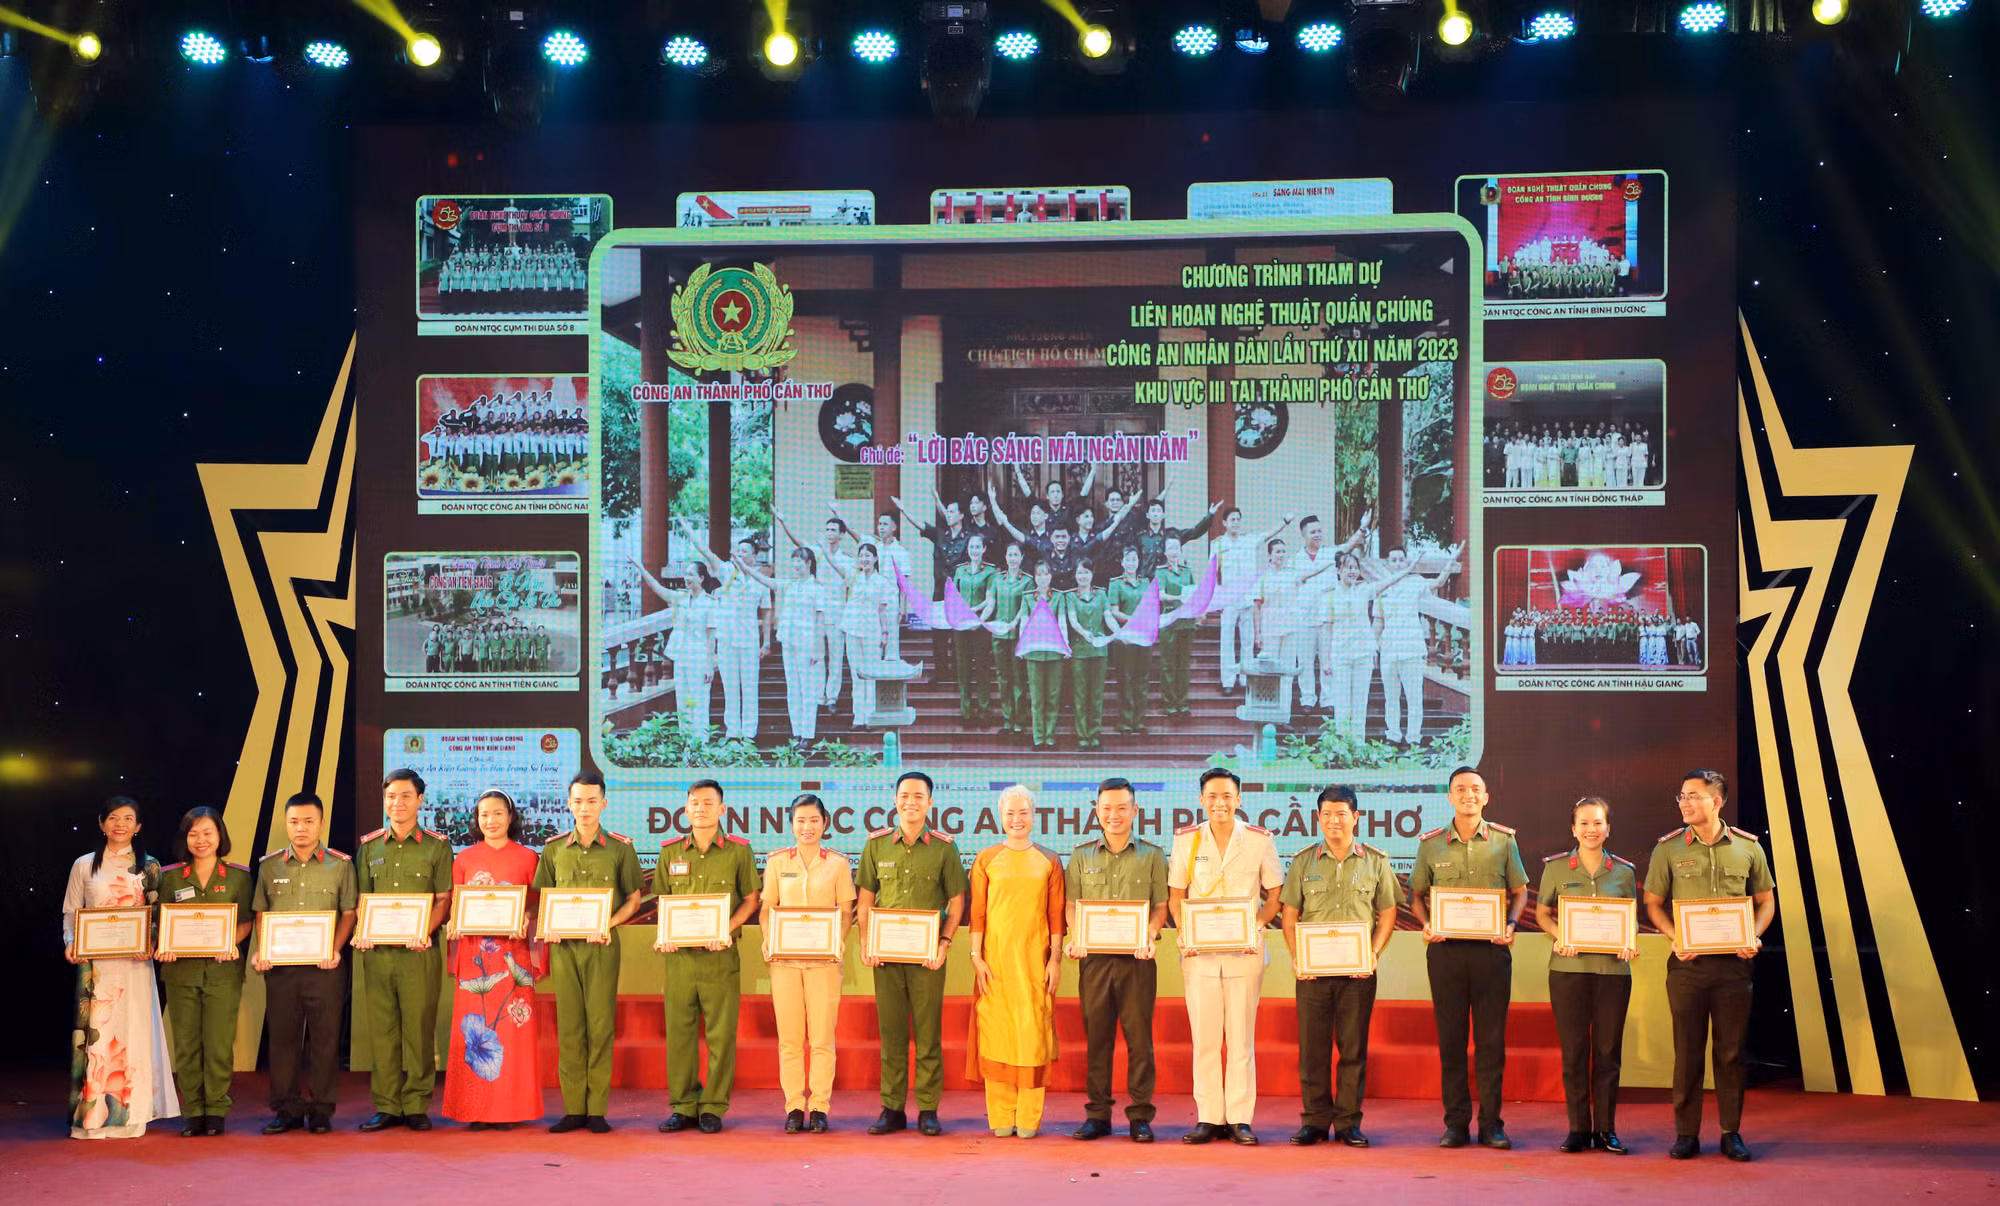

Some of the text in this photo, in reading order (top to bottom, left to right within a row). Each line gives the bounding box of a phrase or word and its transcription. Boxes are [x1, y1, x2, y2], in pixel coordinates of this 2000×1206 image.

[1182, 260, 1383, 289] CHƯƠNG TRÌNH THAM DỰ
[1130, 293, 1433, 331] LIÊN HOAN NGHỆ THUẬT QUẦN CHÚNG
[1502, 308, 1525, 317] NTQC
[1527, 306, 1551, 316] CÔNG
[1553, 307, 1566, 315] AN
[569, 324, 575, 332] 8
[1106, 333, 1459, 367] CÔNG AN NHÂN DÂN LẦN THỨ XII NĂM 2023
[632, 378, 834, 400] CÔNG AN THÀNH PHỐ CẦN THƠ
[1134, 369, 1430, 408] KHU VỰC III TẠI THÀNH PHỐ CẦN THƠ
[860, 442, 884, 464] Chủ
[887, 442, 904, 464] đề:
[950, 433, 989, 464] BÁC
[991, 431, 1042, 464] SÁNG
[1047, 432, 1084, 464] MÃI
[1088, 431, 1142, 463] NGÀN
[467, 503, 488, 511] NTQC
[490, 502, 513, 511] CÔNG
[514, 503, 527, 511] AN
[1503, 495, 1526, 504] NTQC
[1528, 494, 1552, 503] CÔNG
[1555, 495, 1568, 503] AN
[431, 681, 452, 690] NTQC
[454, 680, 477, 689] CÔNG
[533, 680, 558, 688] GIANG
[1545, 679, 1568, 688] NTQC
[1570, 678, 1595, 688] CÔNG
[1597, 679, 1610, 688] AN
[1655, 679, 1683, 688] GIANG
